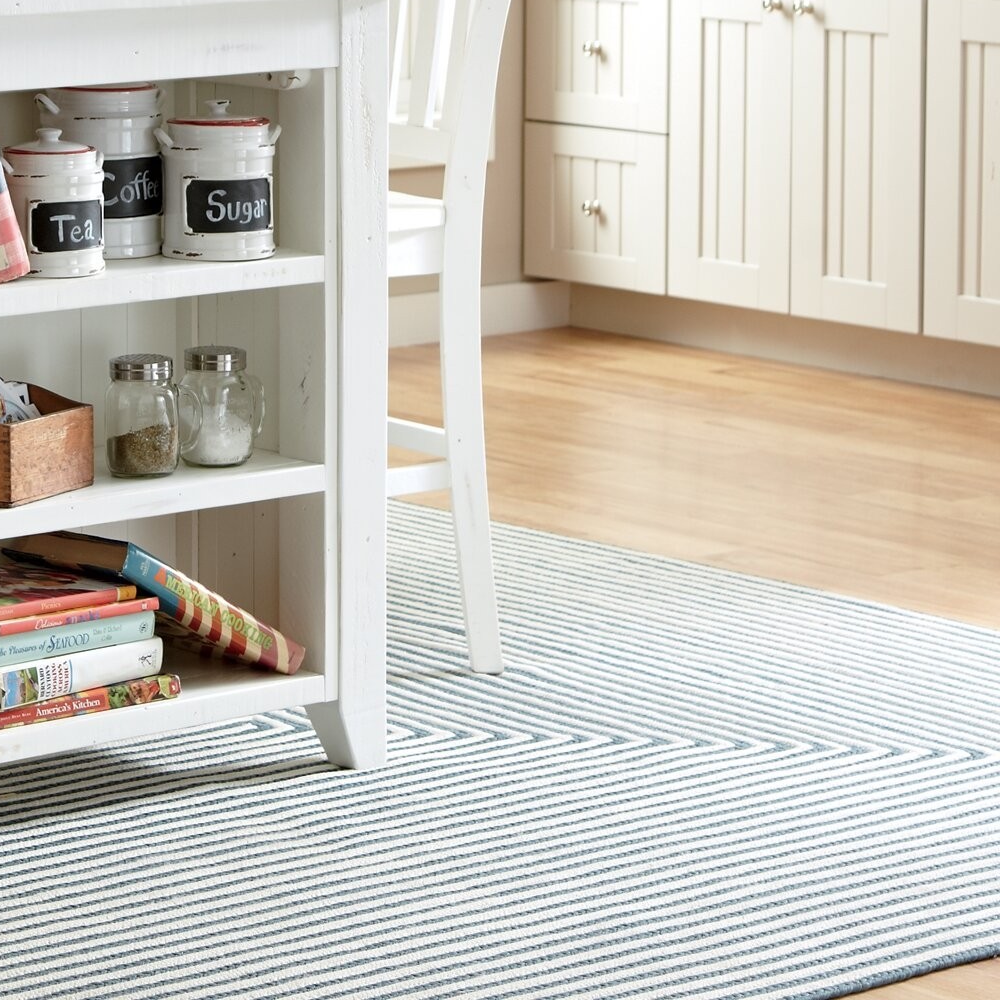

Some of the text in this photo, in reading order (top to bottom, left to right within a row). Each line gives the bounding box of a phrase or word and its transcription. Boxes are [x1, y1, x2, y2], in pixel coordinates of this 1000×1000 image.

[103, 170, 160, 206] Coffee
[206, 189, 267, 224] Sugar
[50, 214, 95, 243] Tea
[154, 568, 273, 649] AMERICAN COOKING
[9, 645, 37, 655] Pleasures
[38, 641, 46, 653] of
[46, 633, 90, 653] SEAFOOD
[36, 703, 71, 717] America's
[72, 698, 101, 710] Kitchen
